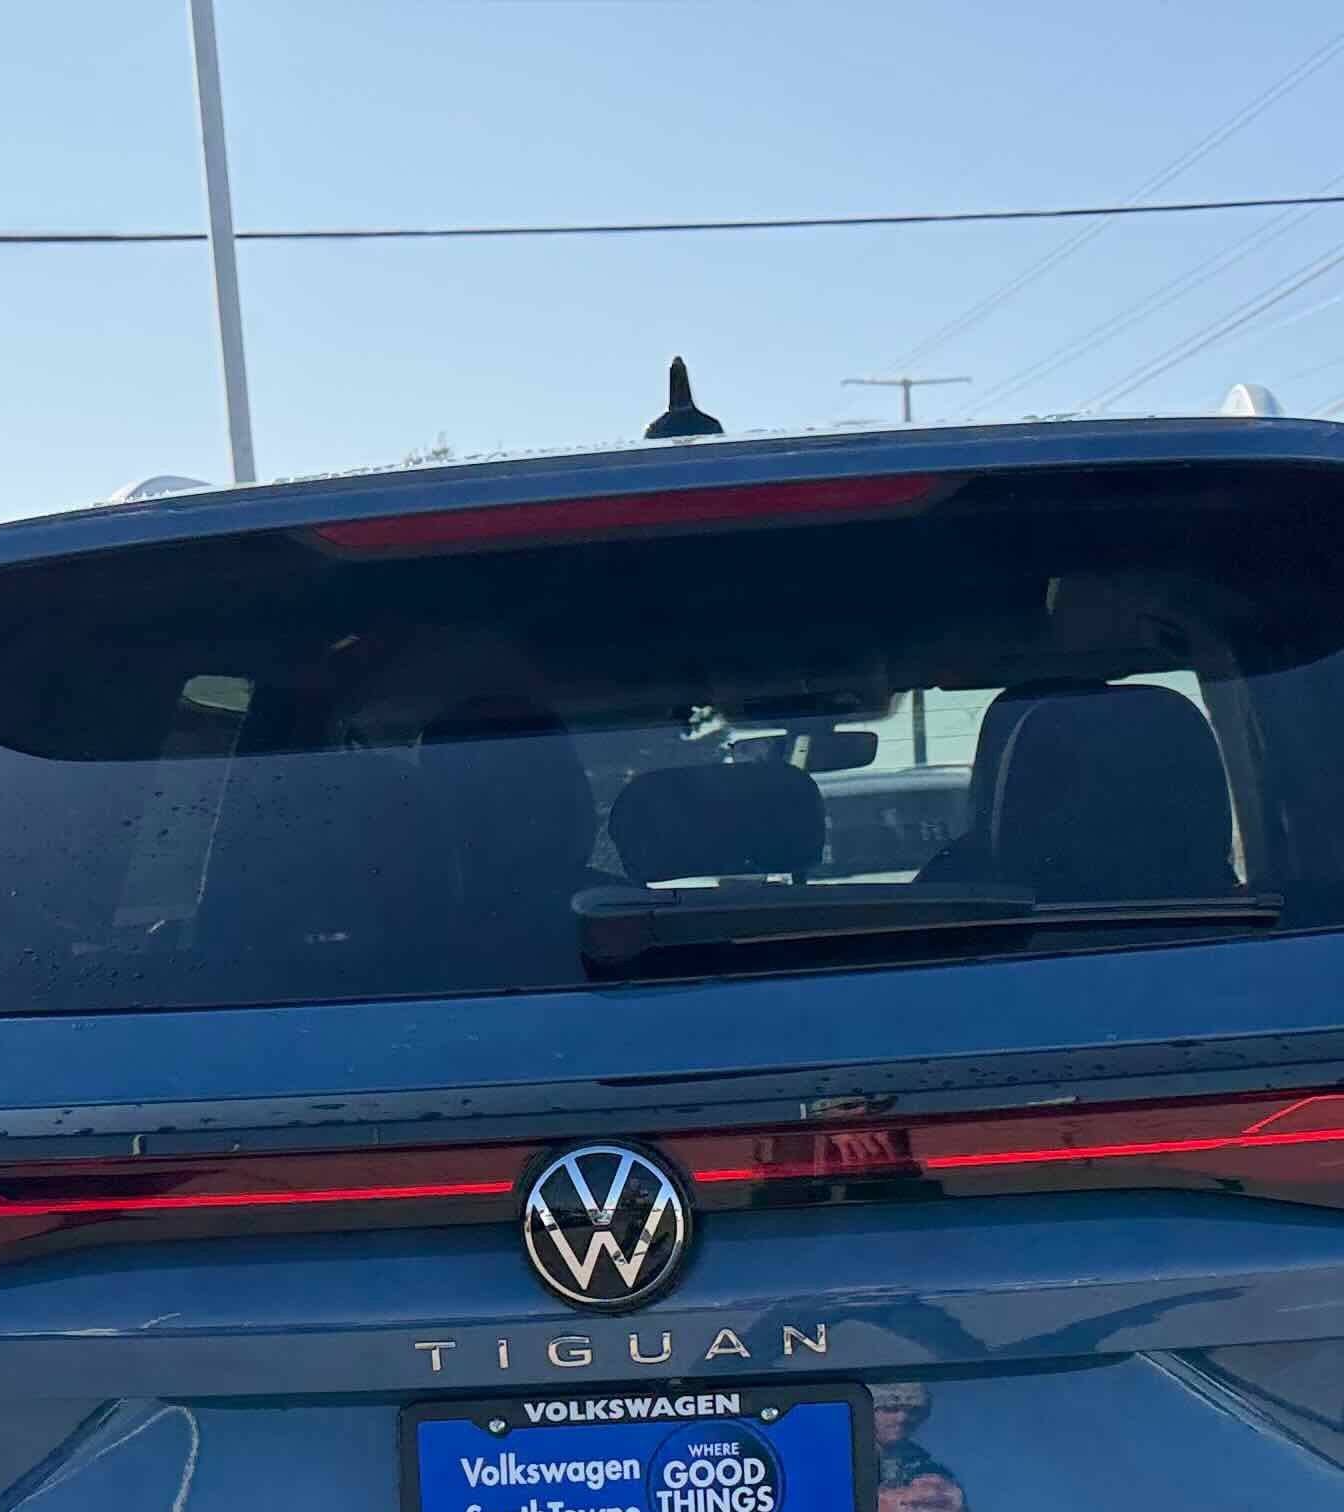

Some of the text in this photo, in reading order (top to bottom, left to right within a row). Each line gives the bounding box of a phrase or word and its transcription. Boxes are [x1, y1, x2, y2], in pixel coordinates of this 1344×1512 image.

[526, 1146, 684, 1302] VW
[414, 1323, 829, 1372] TIGUAN
[524, 1394, 741, 1424] VOLKSWAGEN
[688, 1442, 740, 1458] WHERE
[460, 1453, 641, 1489] Volkswagen
[663, 1457, 766, 1490] GOOD
